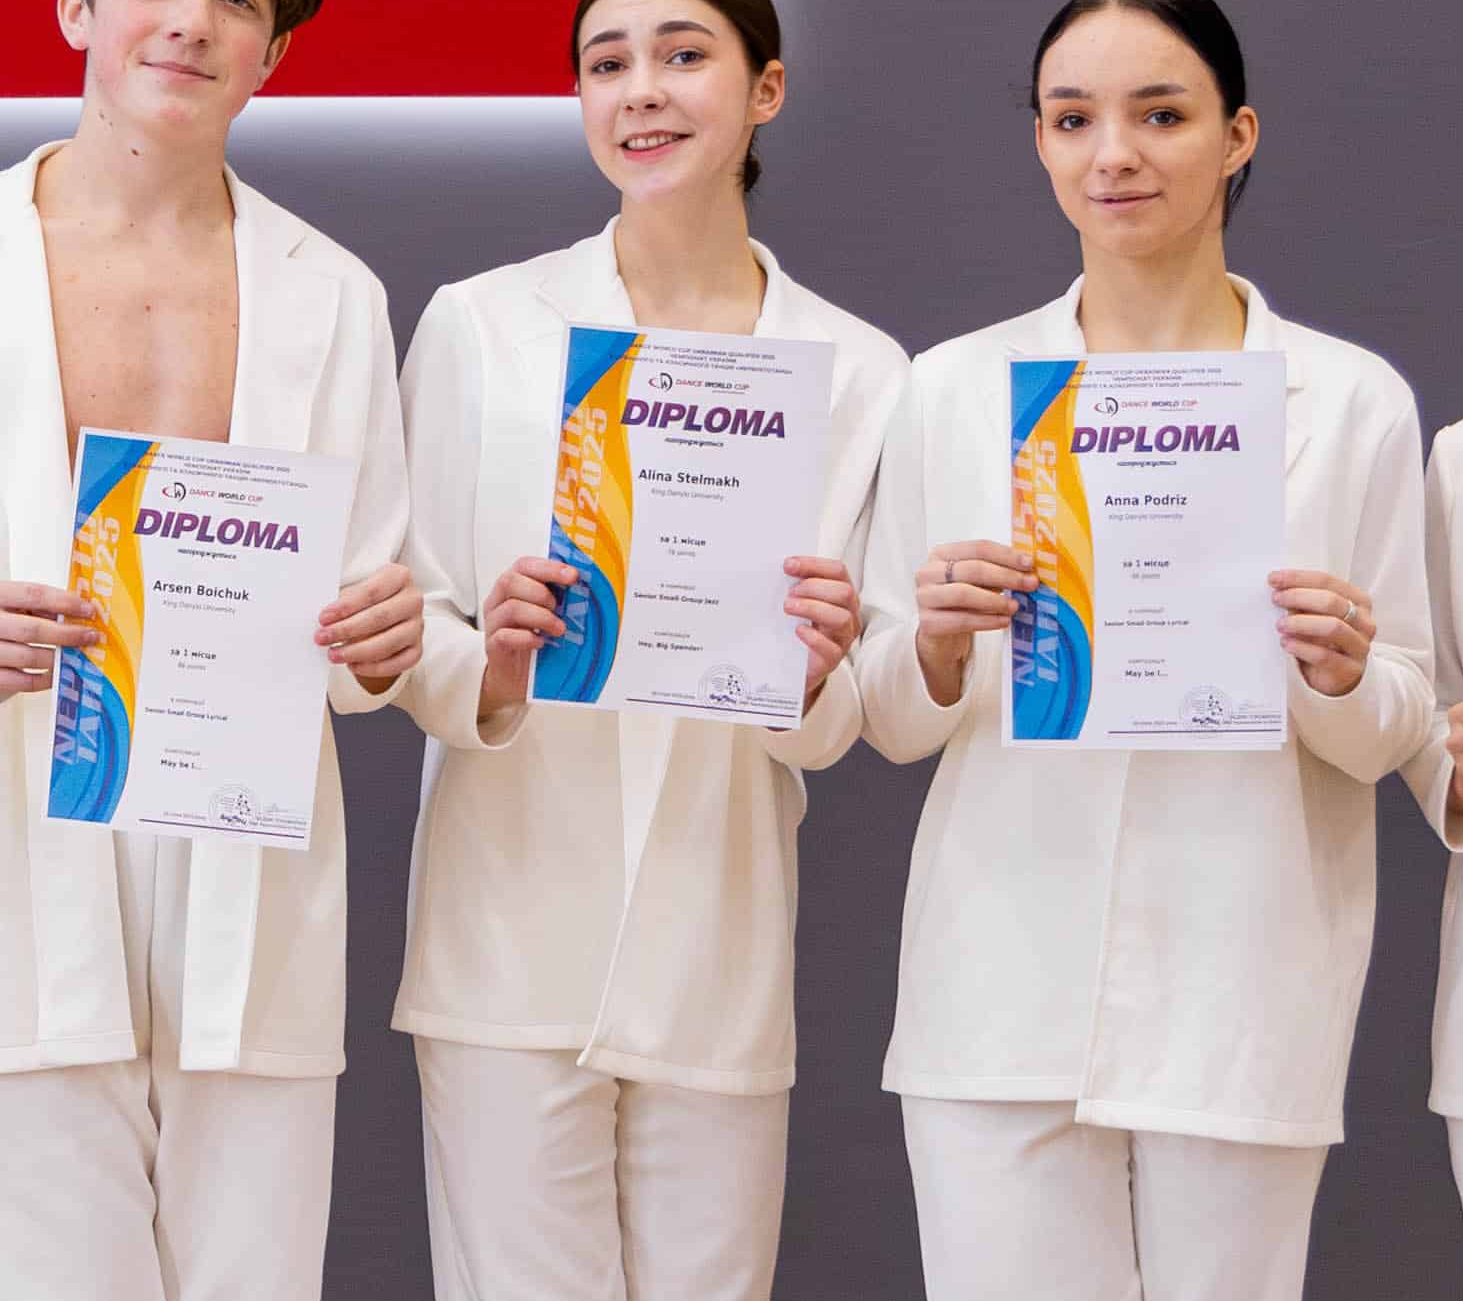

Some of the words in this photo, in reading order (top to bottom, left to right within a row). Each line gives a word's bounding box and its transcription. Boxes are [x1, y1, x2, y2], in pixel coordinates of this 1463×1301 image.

[676, 378, 703, 387] DANCE
[705, 381, 732, 390] WORLD
[621, 399, 785, 438] DIPLOMA
[1071, 425, 1240, 453] DIPLOMA
[638, 468, 672, 483] Alina
[677, 472, 740, 489] Stelmakh
[190, 488, 215, 498] DANCE
[217, 491, 246, 501] WORLD
[1104, 495, 1140, 506] Anna
[1145, 494, 1188, 506] Podriz
[134, 509, 299, 552] DIPLOMA
[153, 579, 192, 594] Arsen
[197, 585, 250, 601] Boichuk
[1125, 669, 1142, 678] May
[161, 759, 176, 769] May
